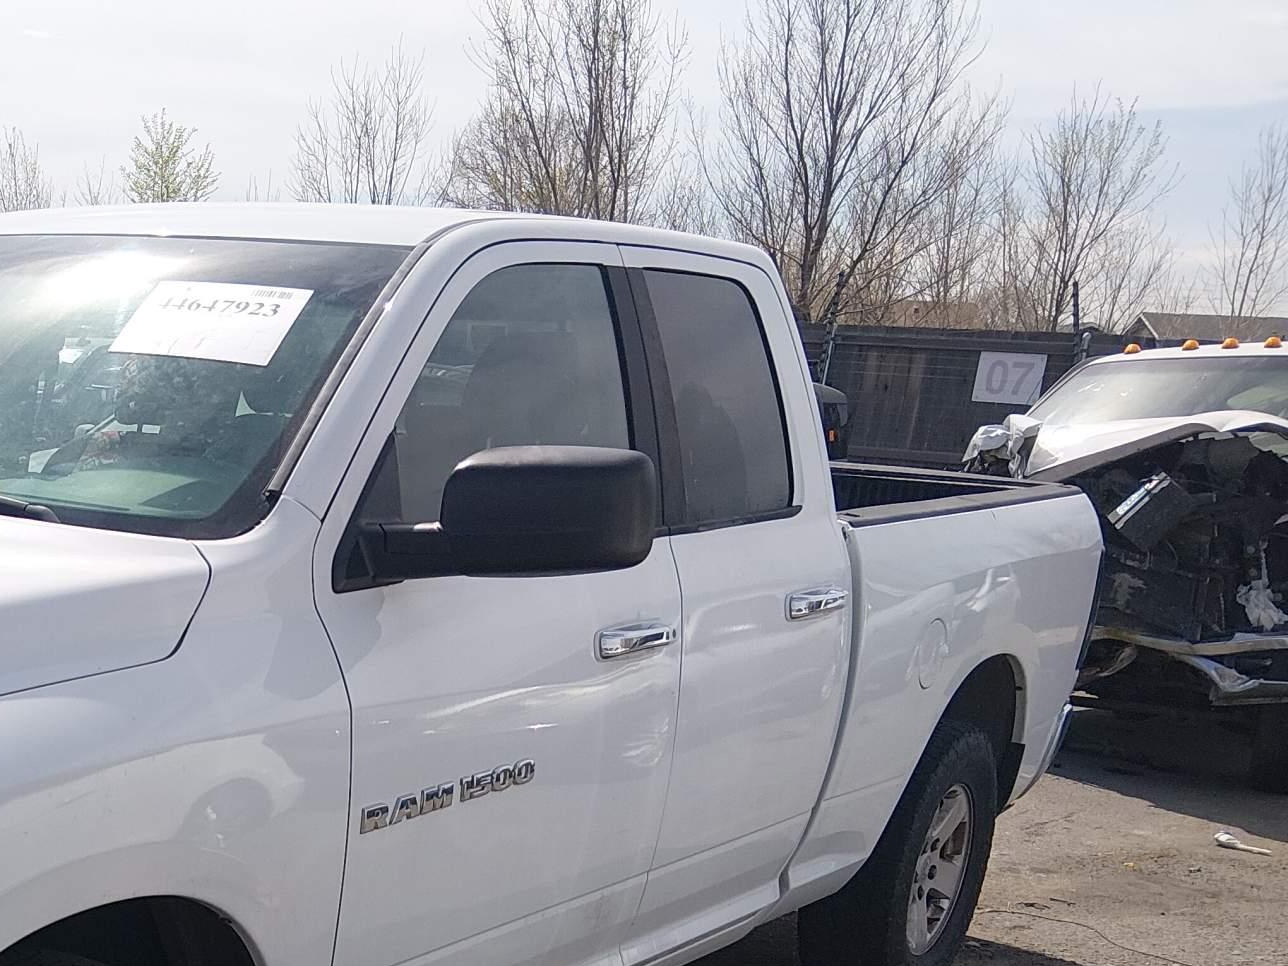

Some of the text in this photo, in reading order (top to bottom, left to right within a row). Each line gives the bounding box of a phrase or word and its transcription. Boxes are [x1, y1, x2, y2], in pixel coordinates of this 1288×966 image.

[159, 297, 281, 317] 44647923
[985, 360, 1035, 395] 07
[360, 757, 536, 835] RAM 1500
